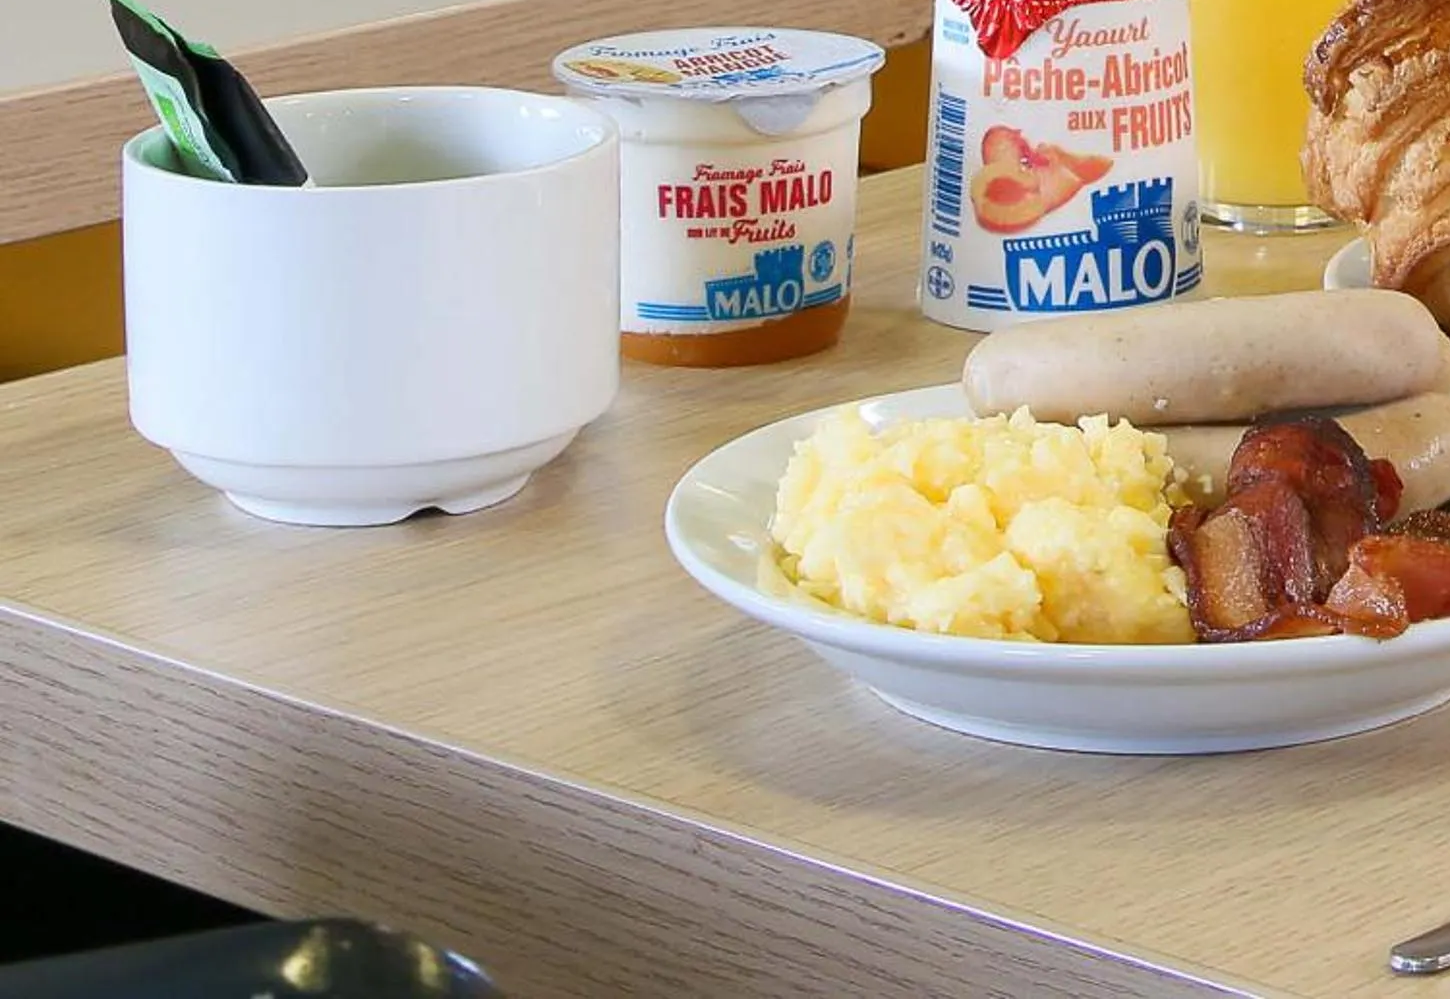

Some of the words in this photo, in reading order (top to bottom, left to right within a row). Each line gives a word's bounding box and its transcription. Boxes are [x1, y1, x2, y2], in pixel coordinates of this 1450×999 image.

[1046, 17, 1150, 58] Yaourt
[983, 41, 1189, 101] Pêche-Abricot
[1068, 109, 1107, 131] aux
[1112, 90, 1192, 152] FRUITS
[692, 164, 764, 184] Fromage
[769, 159, 806, 176] Frais
[657, 184, 748, 219] FRAIS
[759, 170, 832, 215] MALO
[728, 218, 797, 245] Fruits
[1019, 239, 1172, 307] MALO
[714, 279, 801, 318] MALO
